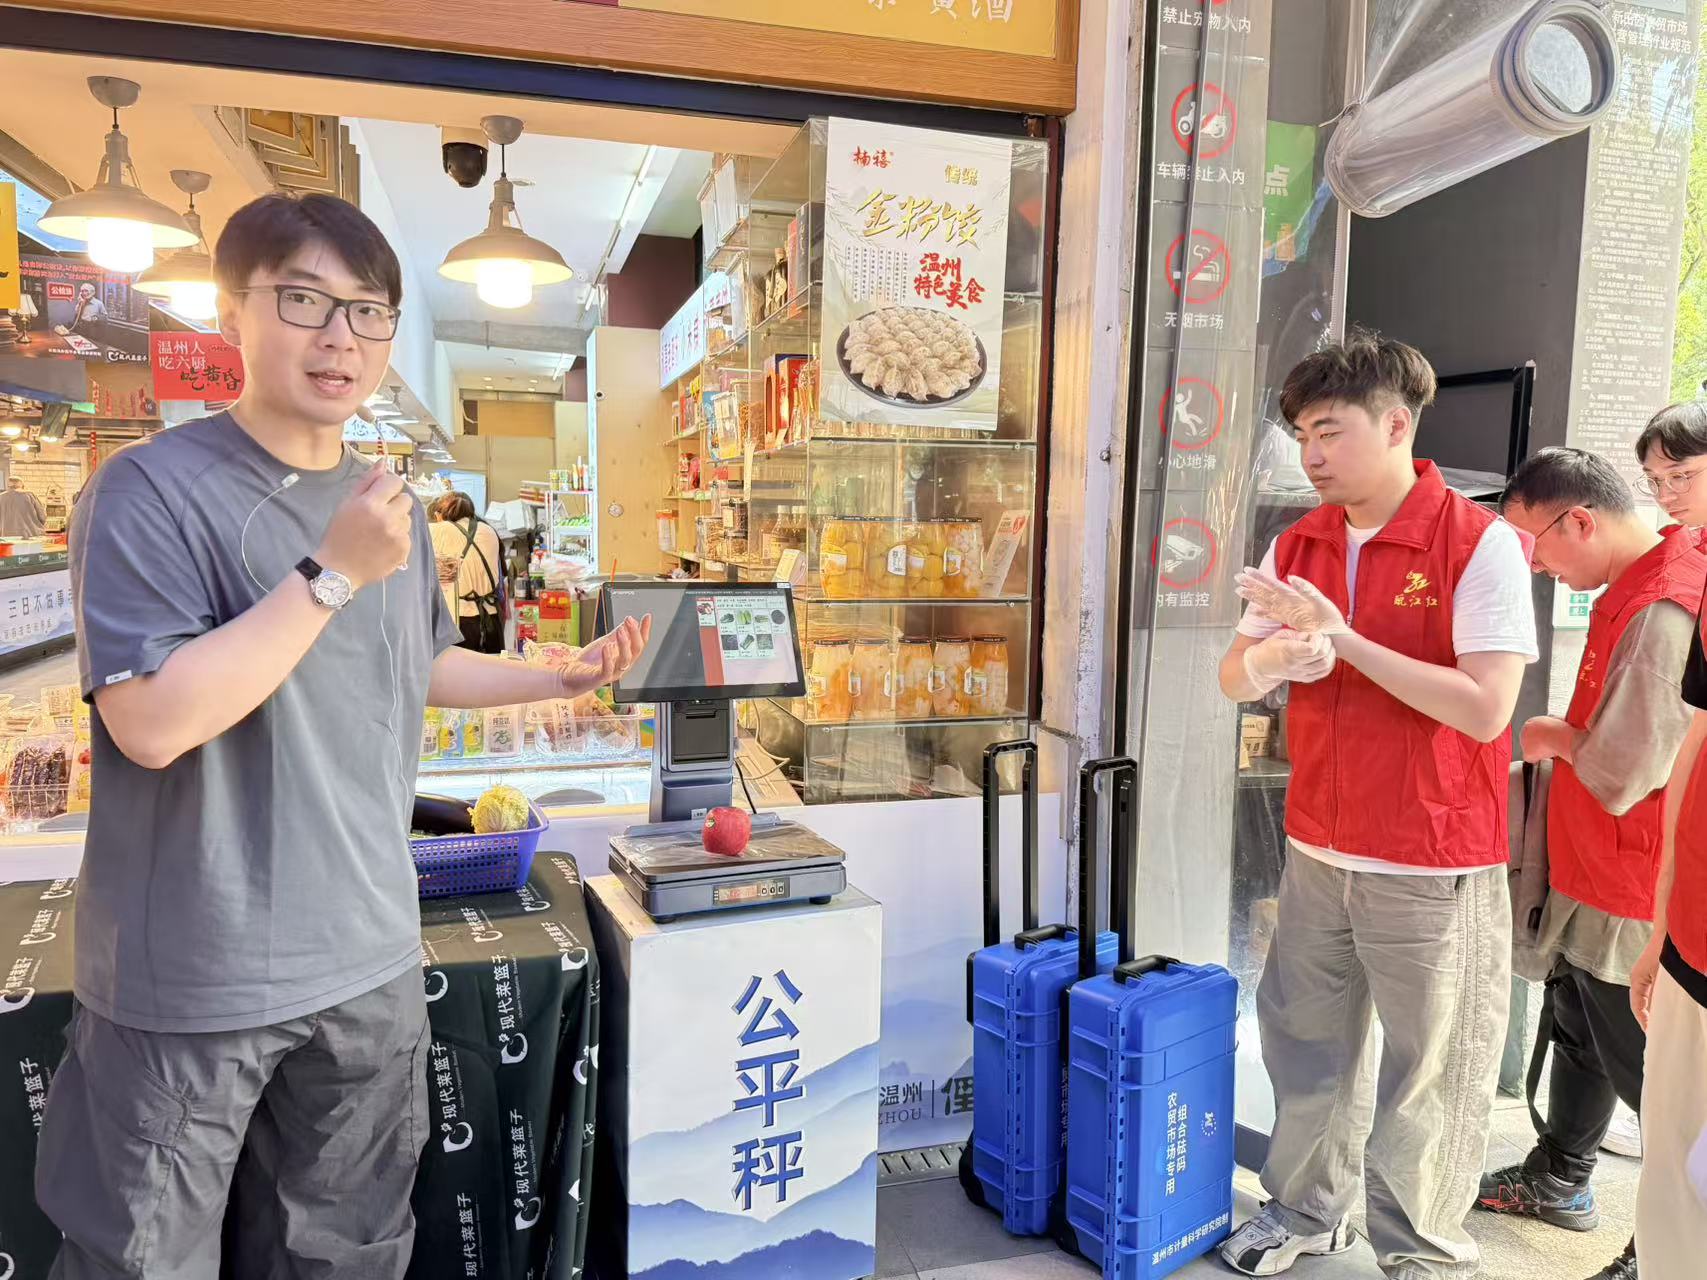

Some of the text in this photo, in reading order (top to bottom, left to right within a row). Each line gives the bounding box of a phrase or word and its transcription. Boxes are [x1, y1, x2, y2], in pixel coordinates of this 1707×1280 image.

[913, 274, 986, 310] 特色美食
[919, 252, 962, 282] 温州
[158, 340, 206, 355] 温州人
[491, 952, 515, 1030] 现代菜篮子
[431, 1041, 457, 1120] 现代菜篮子
[731, 968, 805, 1212] 公平秤
[880, 1080, 922, 1107] 温州
[509, 1108, 530, 1194] 现代菜篮子
[1165, 1091, 1178, 1197] 农贸市场专用
[1176, 1103, 1187, 1174] 组合砝码
[456, 1192, 479, 1277] 现代菜篮子
[1152, 1212, 1229, 1265] 温州市计量科学研究院制
